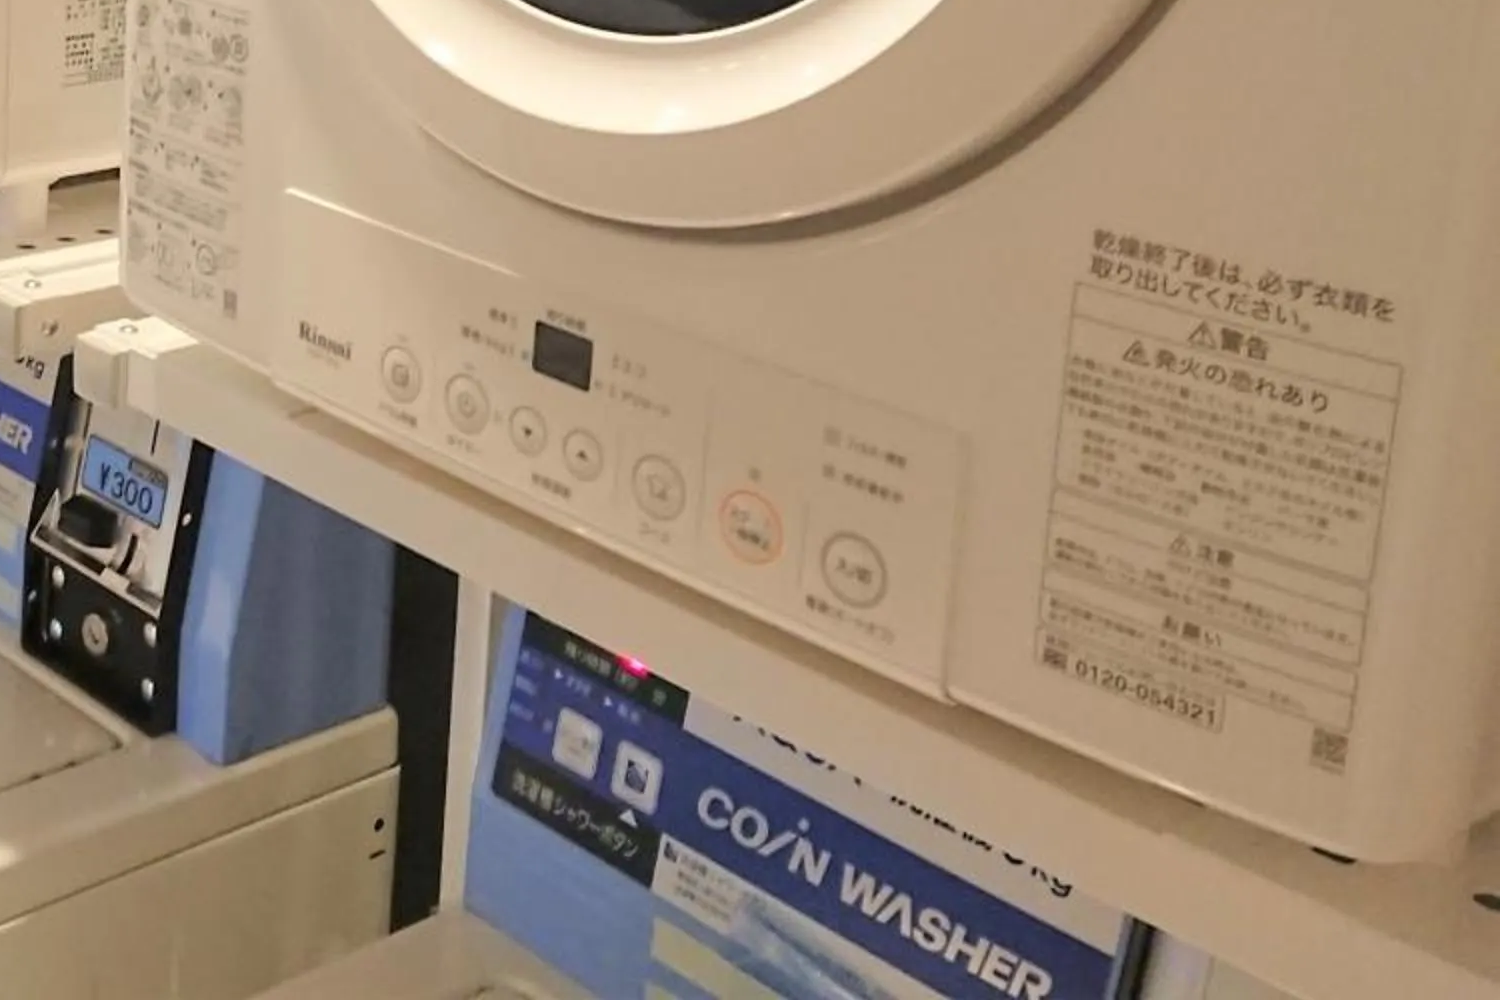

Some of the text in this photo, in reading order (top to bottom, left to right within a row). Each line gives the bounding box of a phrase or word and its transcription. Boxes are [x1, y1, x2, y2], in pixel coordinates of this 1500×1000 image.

[1090, 254, 1312, 333] 取り出してください。
[1093, 228, 1396, 323] 乾燥終了後は、必ず衣類を
[100, 462, 152, 515] ¥300
[1075, 659, 1218, 728] 0120-054321
[838, 860, 1054, 999] WASHER
